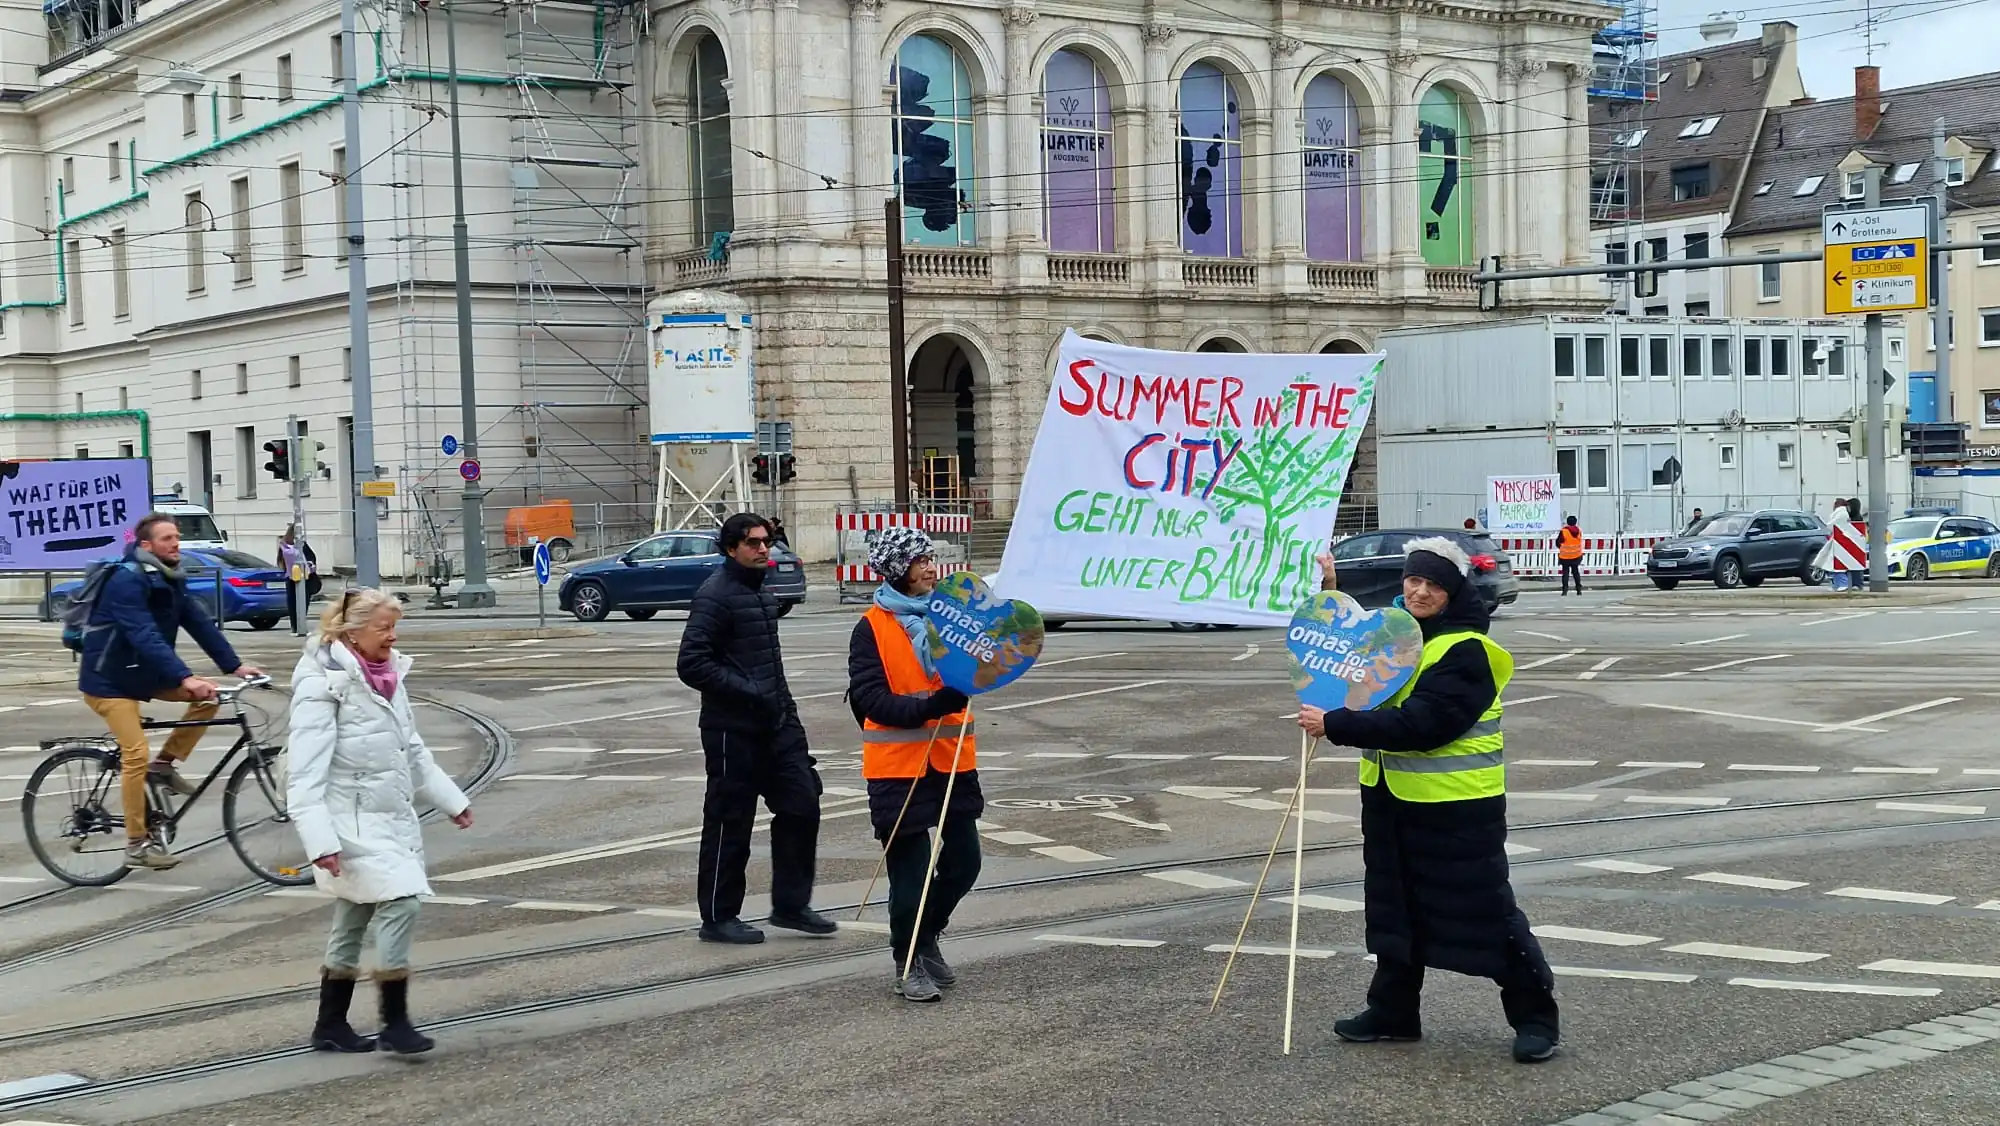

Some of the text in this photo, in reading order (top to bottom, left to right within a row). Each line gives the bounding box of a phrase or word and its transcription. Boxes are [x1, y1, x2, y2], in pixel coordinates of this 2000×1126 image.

[1047, 117, 1093, 127] THEATER
[1852, 227, 1897, 237] Grottenau
[1871, 279, 1913, 288] Klinikum
[1059, 360, 1357, 428] SUMMER IN THE
[8, 483, 53, 505] WAS
[59, 480, 88, 498] FÜR
[1494, 479, 1552, 503] MENSCHEN
[8, 498, 127, 538] THEATER
[1053, 490, 1208, 538] GEHT NUR
[1940, 548, 1964, 559] POLIZEI
[1080, 556, 1185, 589] UNTER
[930, 599, 984, 634] omas
[939, 624, 994, 663] future
[976, 631, 998, 649] for
[1289, 626, 1352, 655] omas
[1301, 649, 1367, 683] future
[1344, 650, 1369, 667] for
